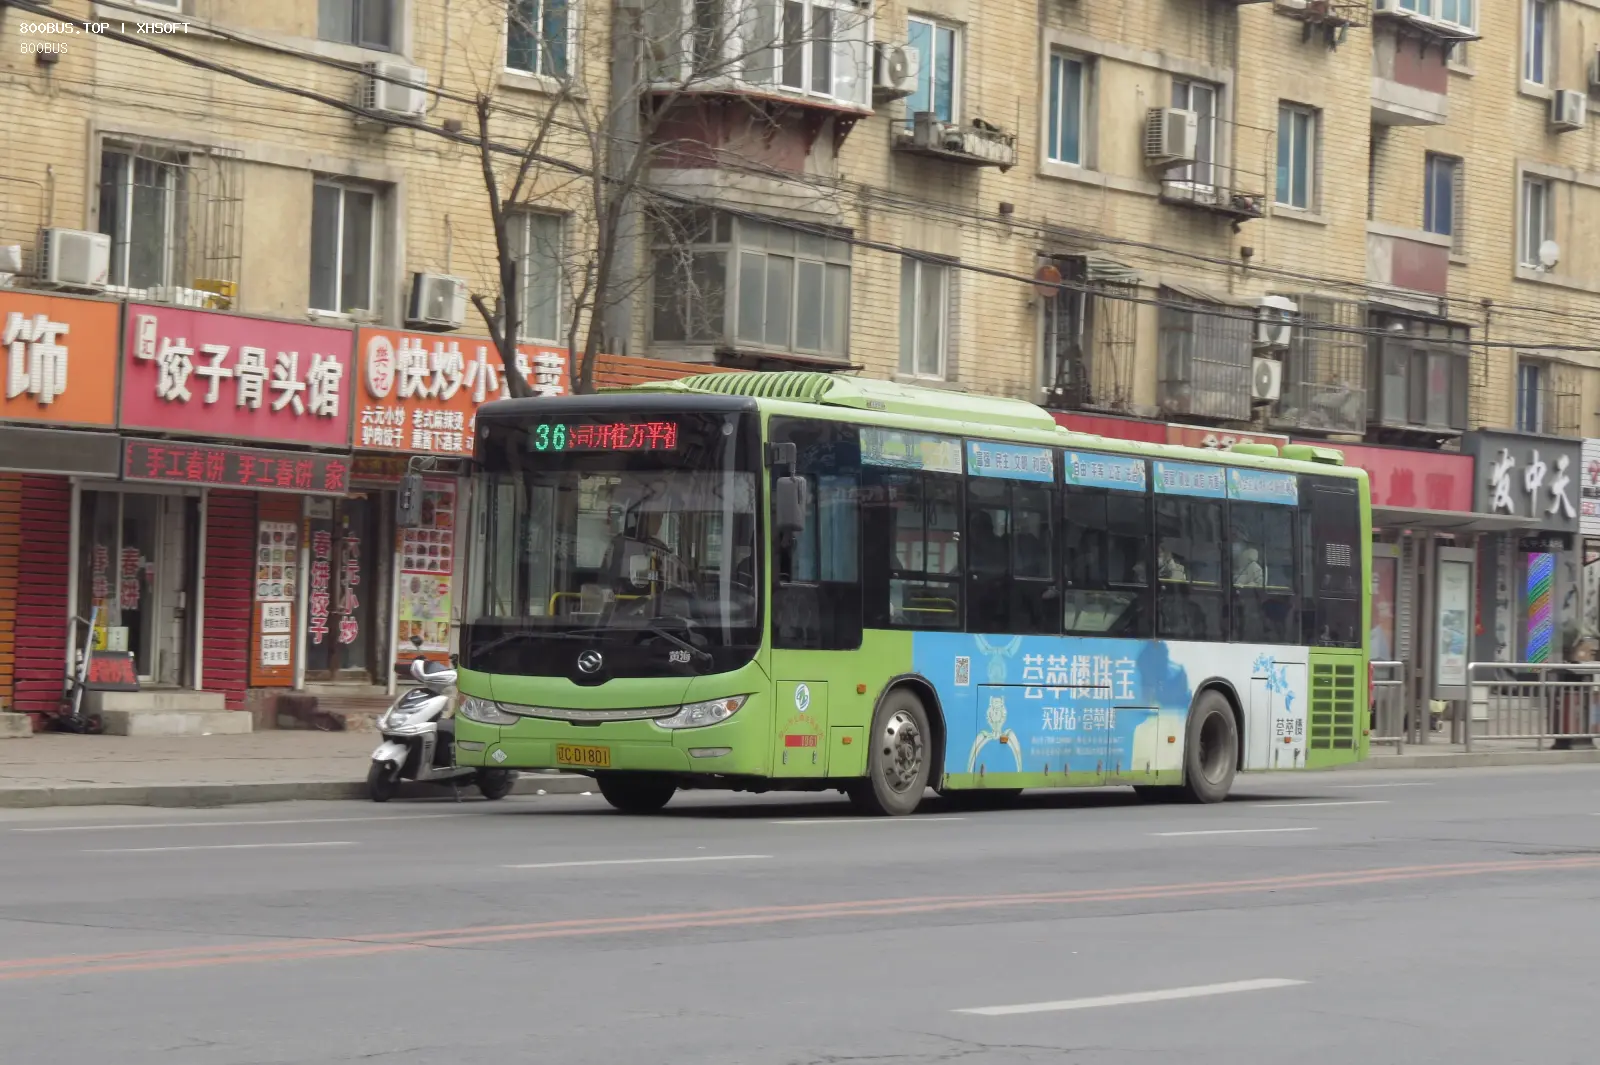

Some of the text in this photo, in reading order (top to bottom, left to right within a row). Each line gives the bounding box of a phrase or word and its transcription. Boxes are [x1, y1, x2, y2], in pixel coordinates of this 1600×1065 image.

[3, 311, 69, 404] 饰
[157, 337, 343, 417] 饺子骨头馆
[396, 337, 566, 403] 快炒小菜
[361, 405, 405, 426] 六元小炒
[535, 424, 566, 450] 36
[146, 447, 346, 489] 手工春饼 手工春饼 家
[338, 533, 361, 645] 六元小炒
[669, 650, 691, 663] 黄海
[1022, 653, 1136, 700] 荟萃楼珠宝
[1276, 718, 1303, 736] 荟萃楼
